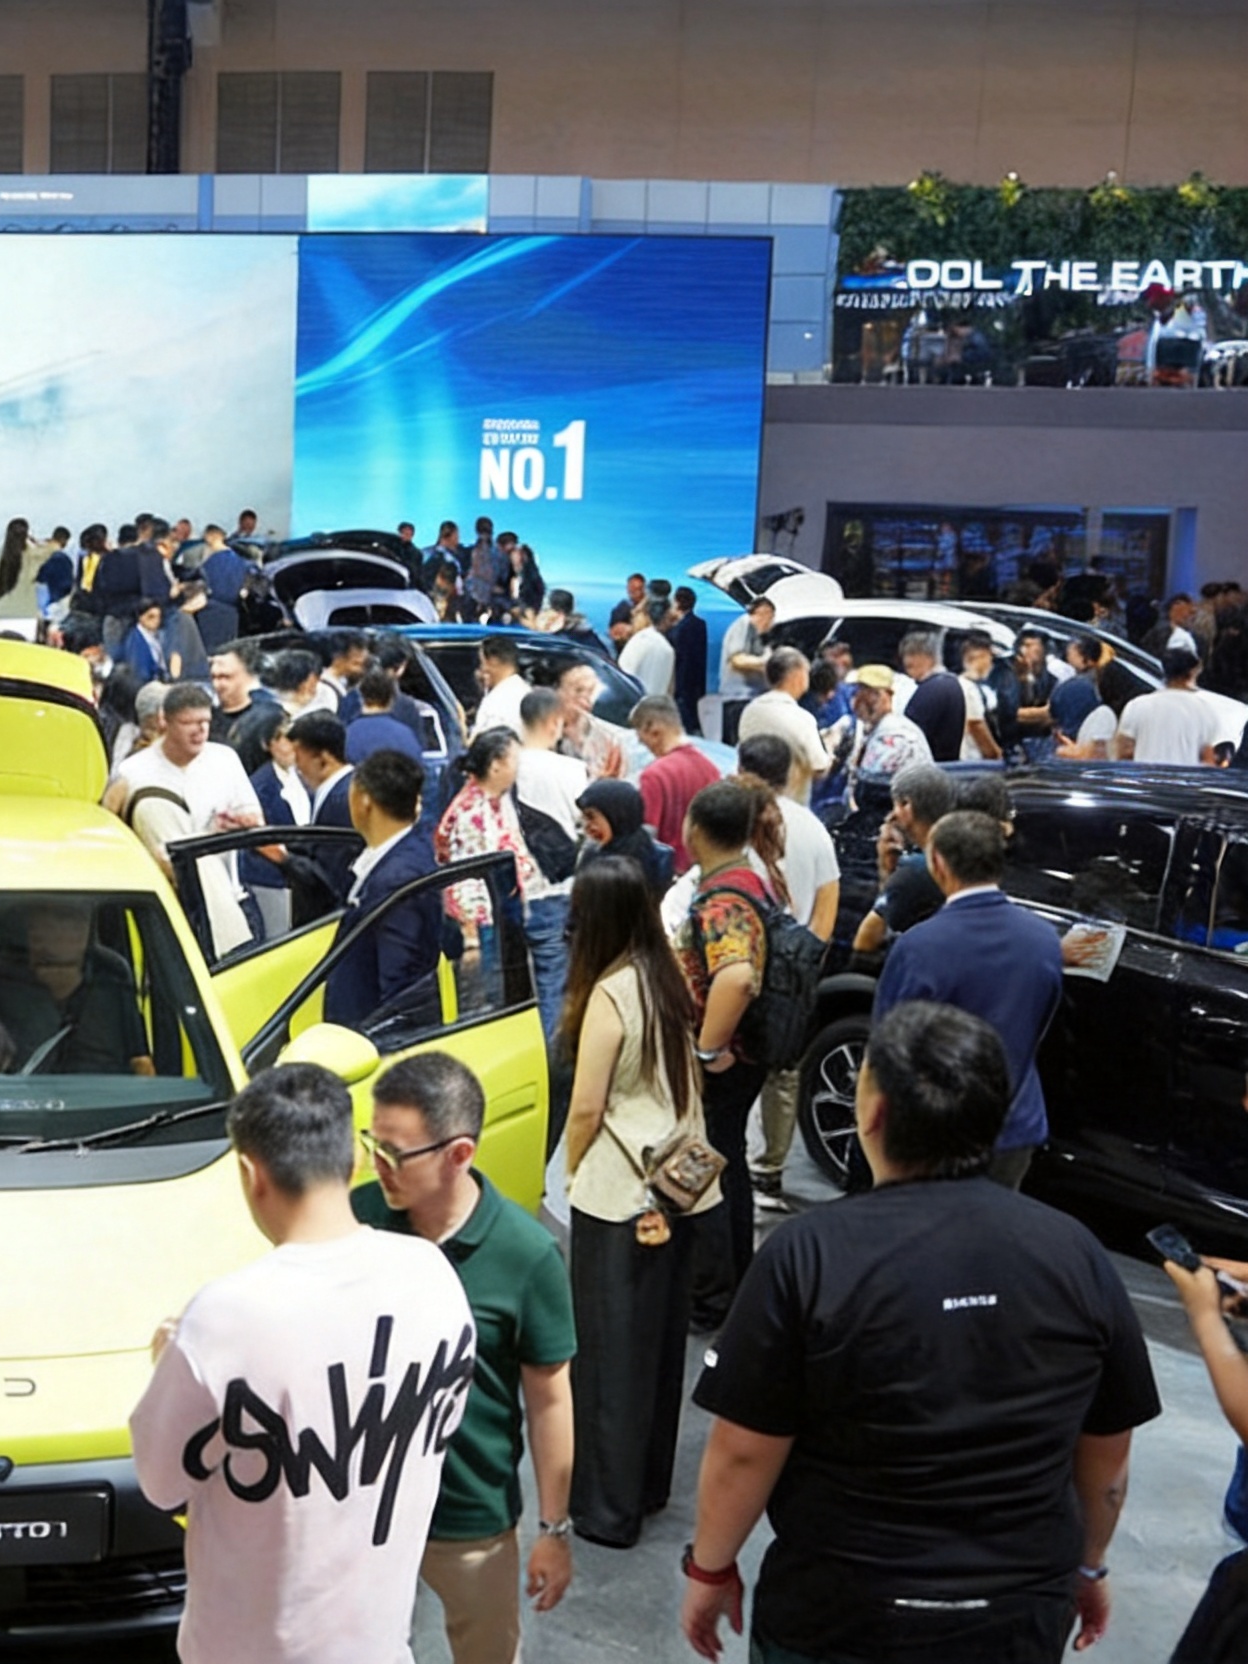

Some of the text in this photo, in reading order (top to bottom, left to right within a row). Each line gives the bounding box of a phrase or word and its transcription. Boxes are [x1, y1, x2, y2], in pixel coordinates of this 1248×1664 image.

[897, 260, 1003, 289] OOL
[1011, 260, 1101, 295] THE
[480, 419, 586, 501] NO.1
